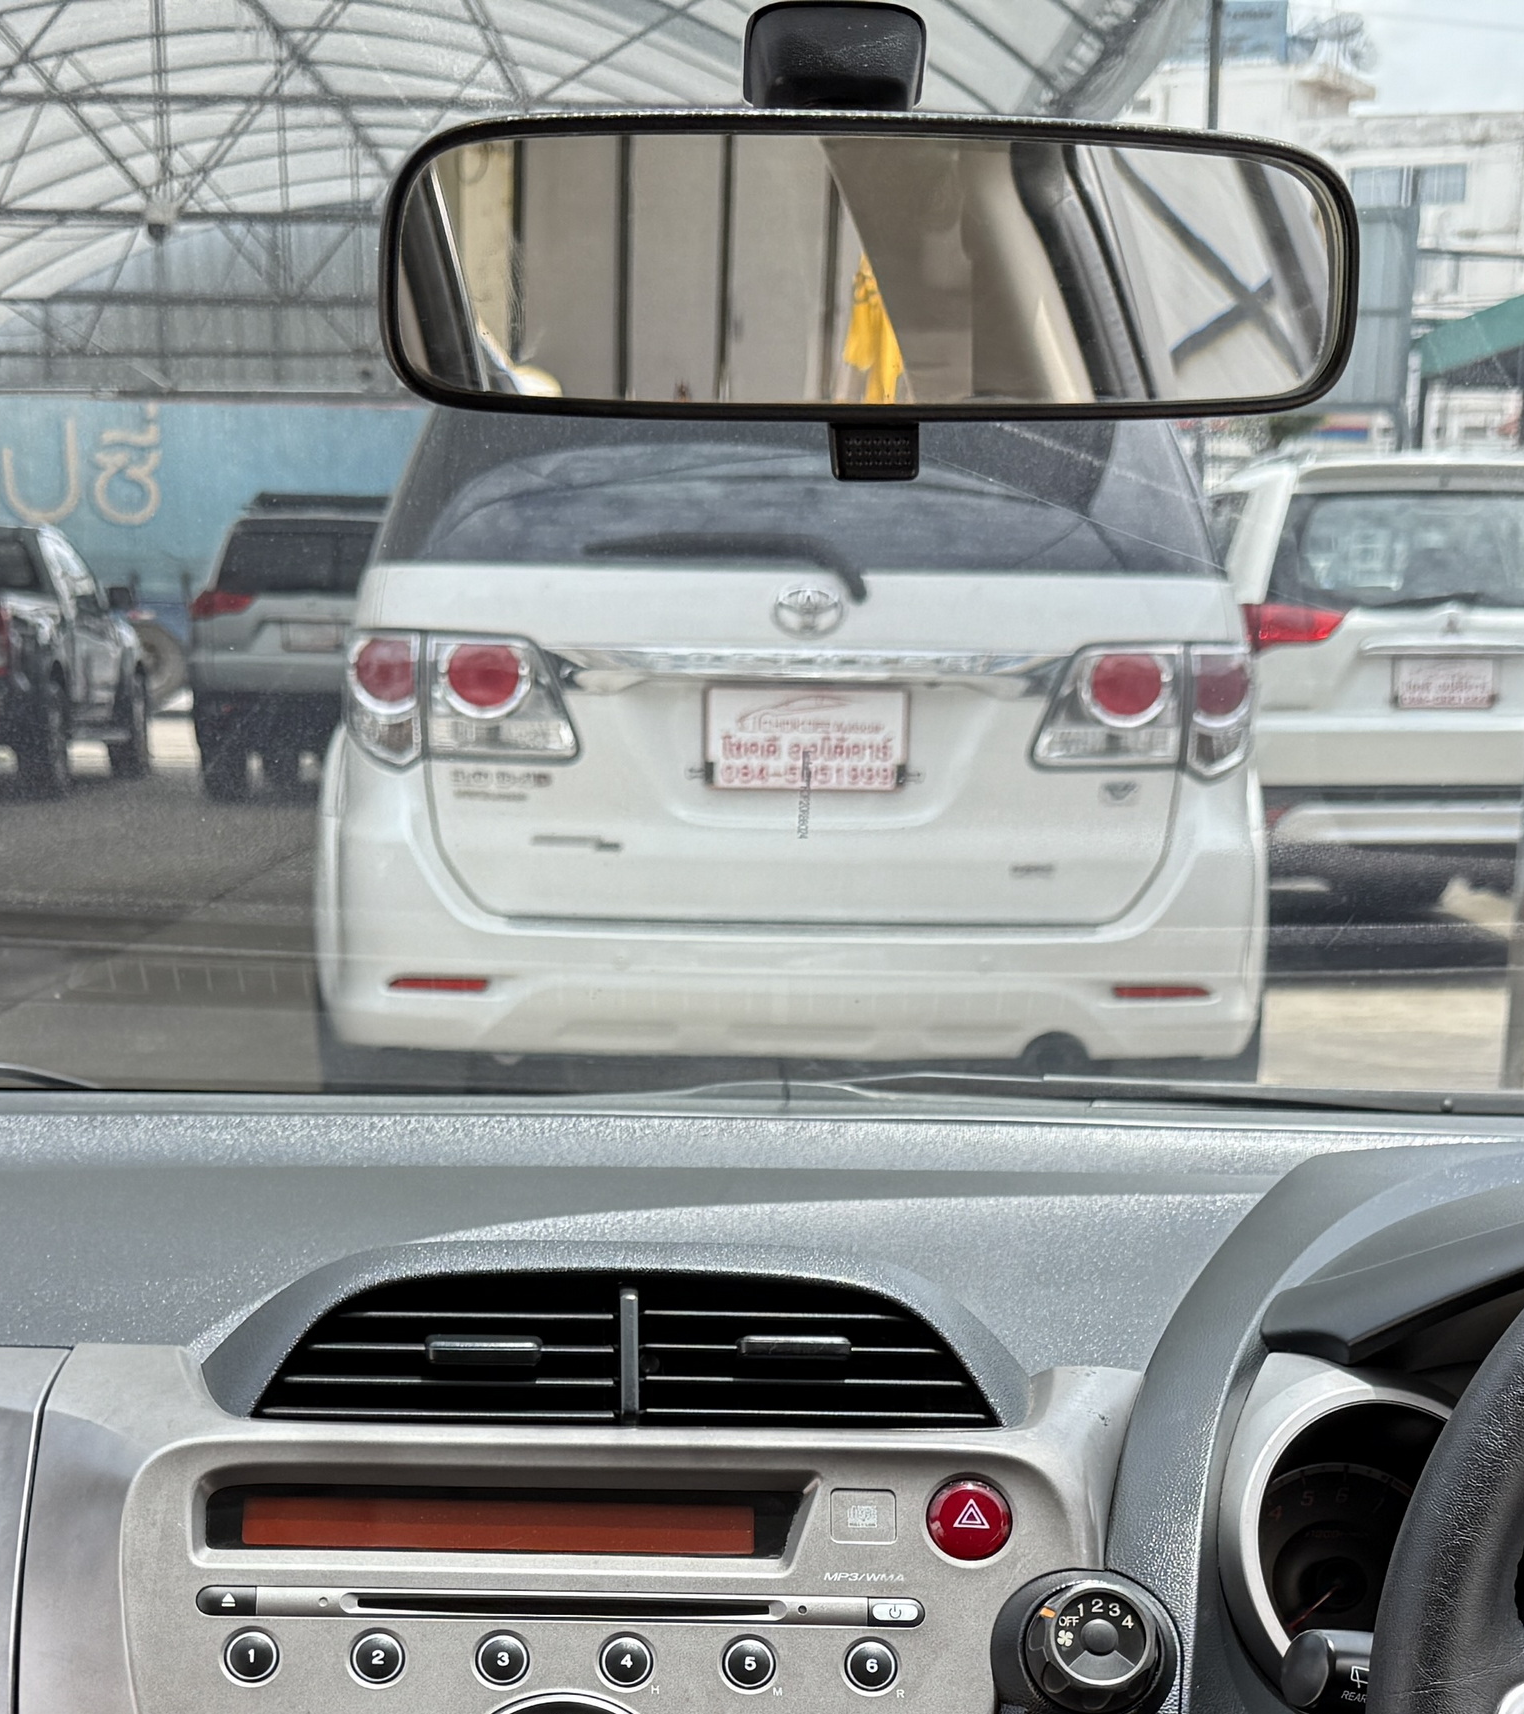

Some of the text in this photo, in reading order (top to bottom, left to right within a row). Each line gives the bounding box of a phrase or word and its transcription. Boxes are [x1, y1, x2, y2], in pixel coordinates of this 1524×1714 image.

[1300, 1490, 1315, 1506] 5
[1335, 1487, 1350, 1504] 6
[1268, 1505, 1283, 1521] 4
[824, 1572, 905, 1583] MP3/WMA
[1077, 1603, 1085, 1617] 1
[1091, 1599, 1103, 1613] 2
[1109, 1603, 1121, 1617] 3
[1059, 1615, 1079, 1627] OFF
[1122, 1616, 1135, 1629] 4
[247, 1648, 257, 1664] 1
[371, 1649, 386, 1665] 2
[496, 1651, 511, 1667] 3
[620, 1653, 634, 1669] 4
[744, 1656, 757, 1672] 5
[866, 1657, 879, 1673] 6
[773, 1687, 783, 1697] M
[896, 1689, 906, 1699] R
